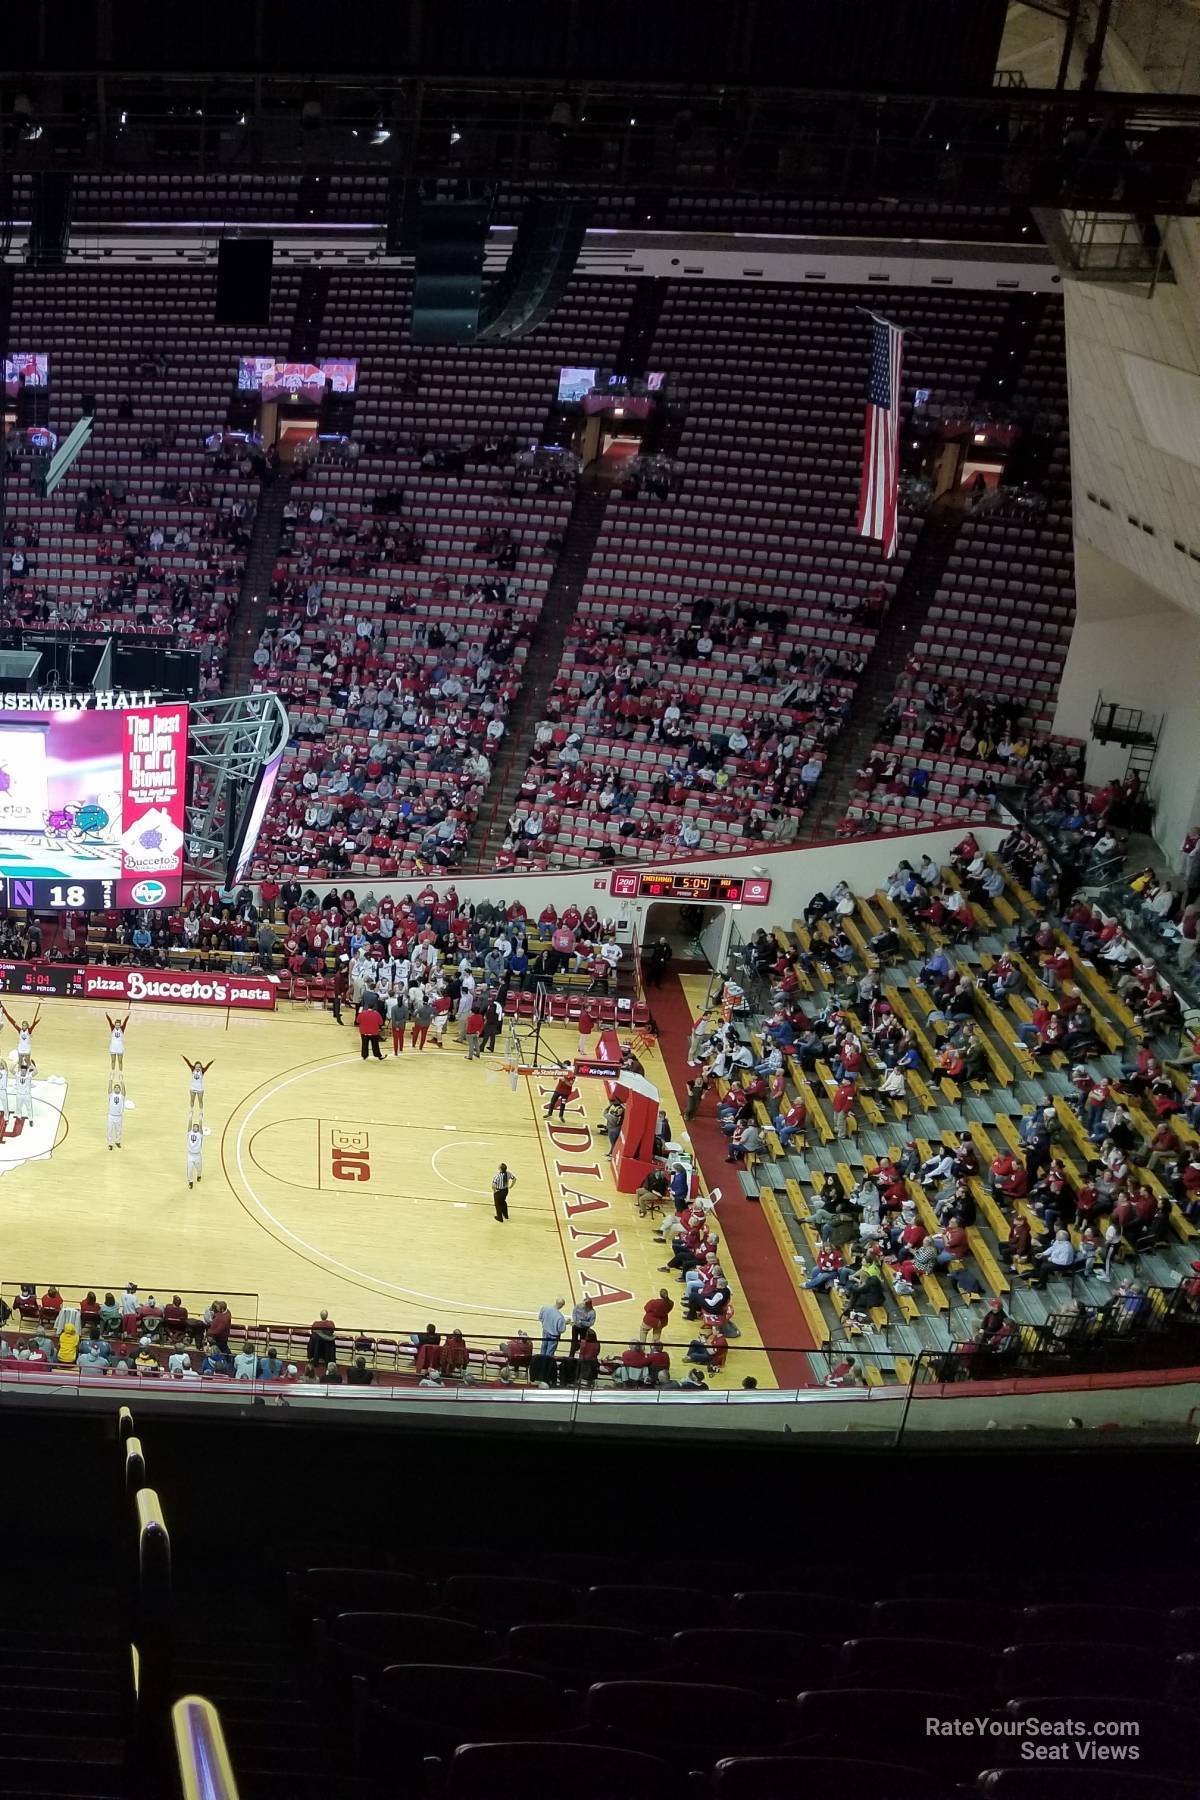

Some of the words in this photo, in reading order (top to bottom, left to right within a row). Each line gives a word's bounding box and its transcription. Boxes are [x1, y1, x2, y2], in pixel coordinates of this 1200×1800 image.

[94, 690, 156, 710] HALL
[126, 715, 150, 735] The
[153, 714, 180, 734] best
[133, 732, 173, 752] Italian
[144, 750, 160, 770] all
[162, 749, 177, 770] of
[126, 856, 178, 868] Bucceto's
[14, 880, 34, 906] N
[650, 884, 660, 894] 18
[682, 878, 708, 888] 5:04
[50, 886, 85, 907] 18
[727, 889, 738, 898] 18
[25, 974, 50, 985] 5:04
[88, 977, 124, 992] pizza
[127, 972, 228, 1000] Bucceto's
[230, 988, 271, 1002] pasta
